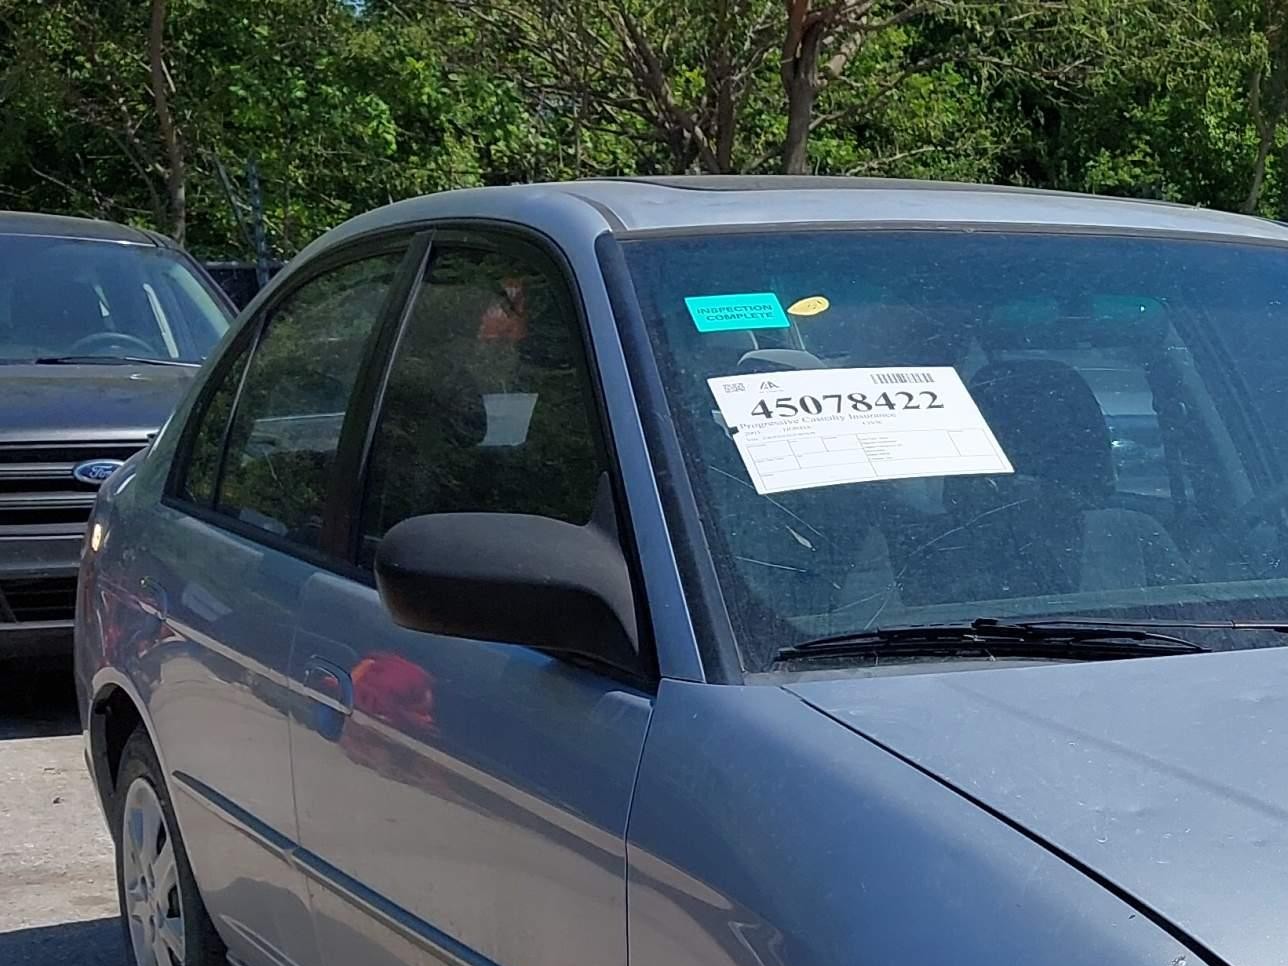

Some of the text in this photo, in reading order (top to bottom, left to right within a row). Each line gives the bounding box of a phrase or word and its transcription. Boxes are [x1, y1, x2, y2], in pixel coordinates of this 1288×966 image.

[697, 304, 773, 315] INSPECTION
[706, 311, 776, 322] COMPLETE
[751, 391, 945, 419] 45078422
